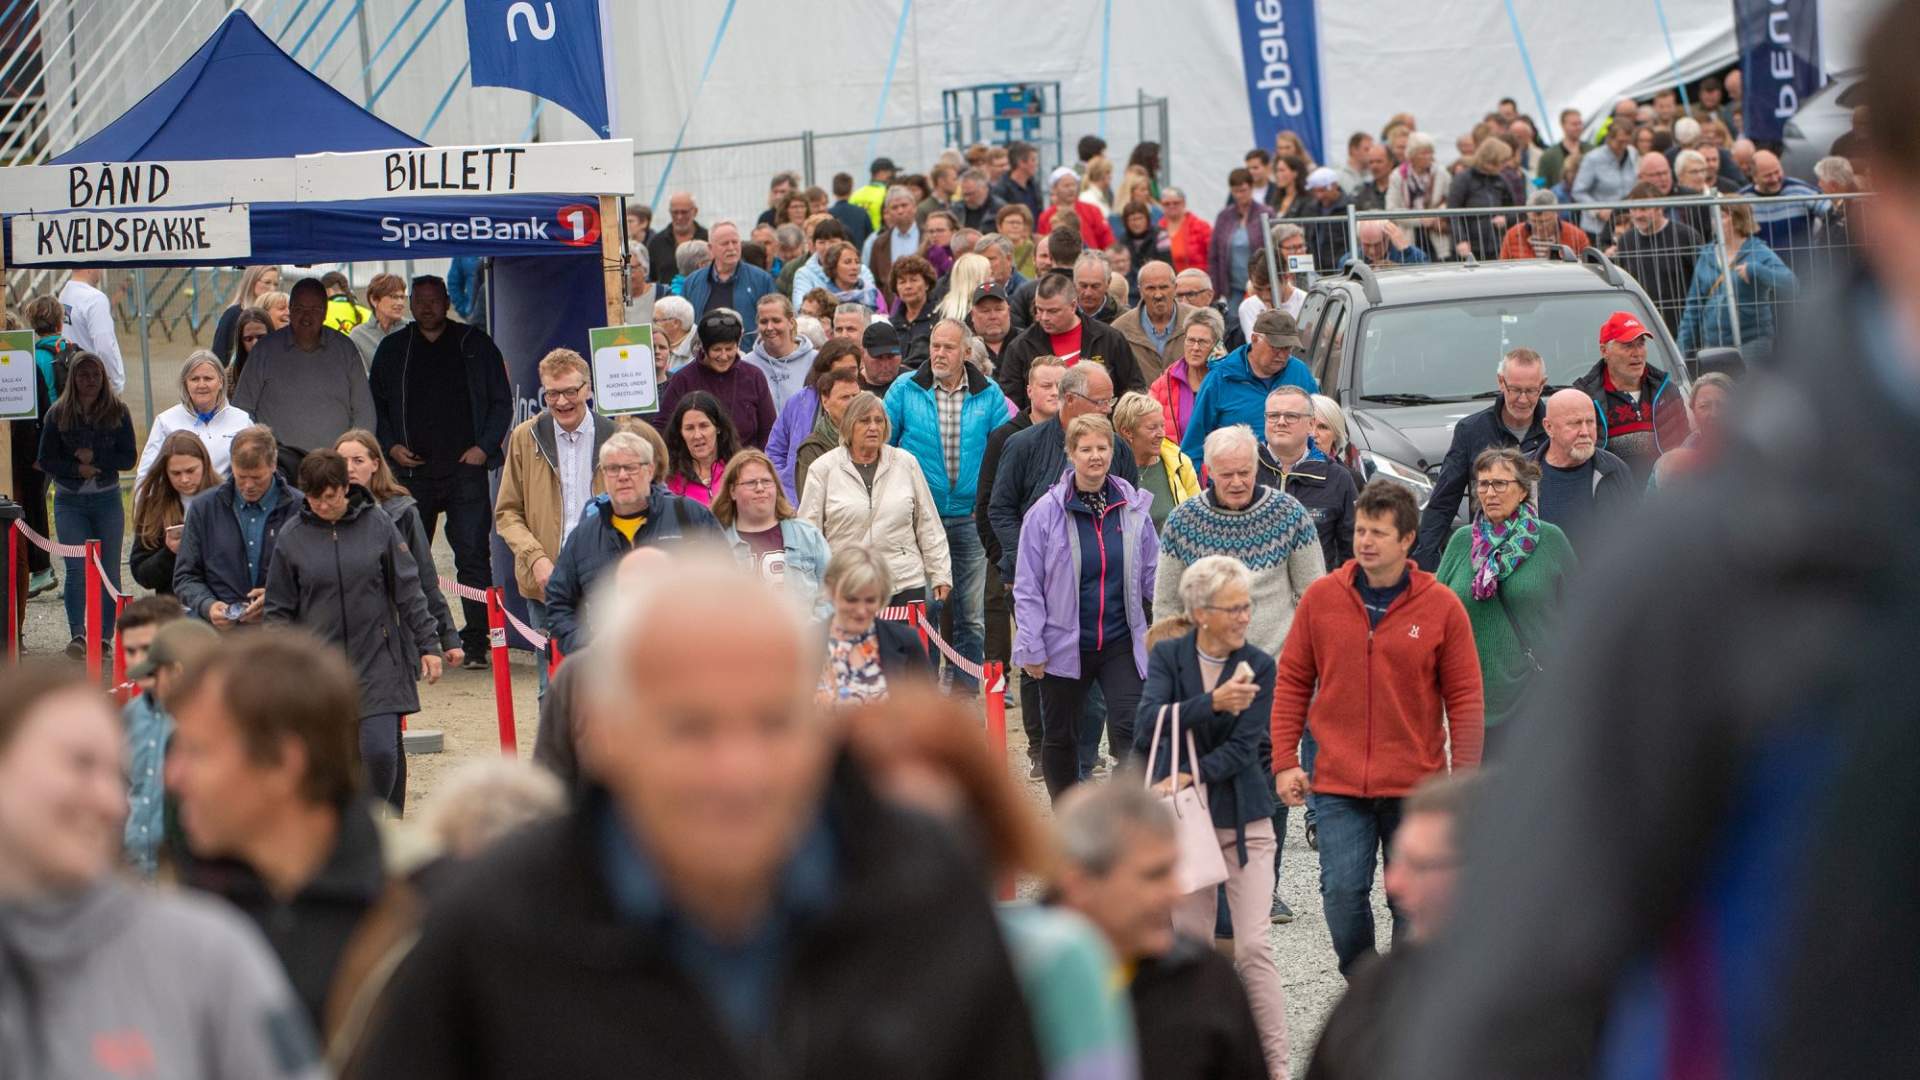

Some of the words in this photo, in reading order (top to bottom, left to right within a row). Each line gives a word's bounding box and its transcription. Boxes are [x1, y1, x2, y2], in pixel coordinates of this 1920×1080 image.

[385, 148, 526, 192] BILLETT
[37, 217, 211, 256] KVELDSPAKKE
[380, 216, 549, 248] SpareBank
